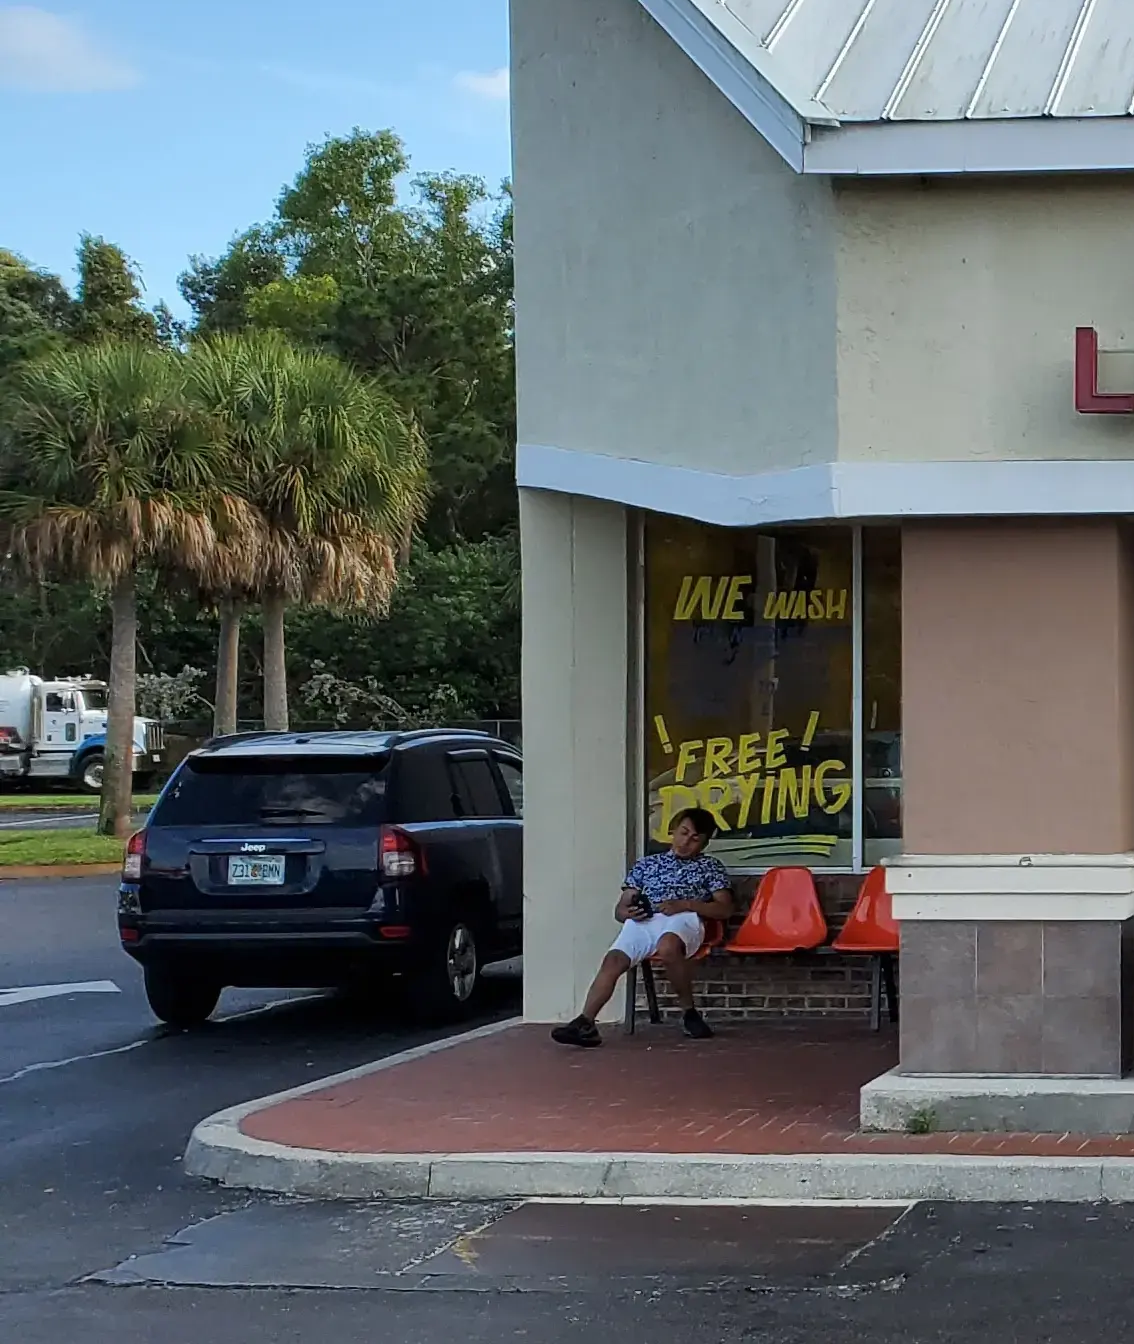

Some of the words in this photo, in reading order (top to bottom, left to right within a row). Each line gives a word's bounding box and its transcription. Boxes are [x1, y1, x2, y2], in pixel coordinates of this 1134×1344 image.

[673, 575, 752, 620] WE
[763, 588, 848, 620] WASH
[241, 843, 266, 852] Jeep
